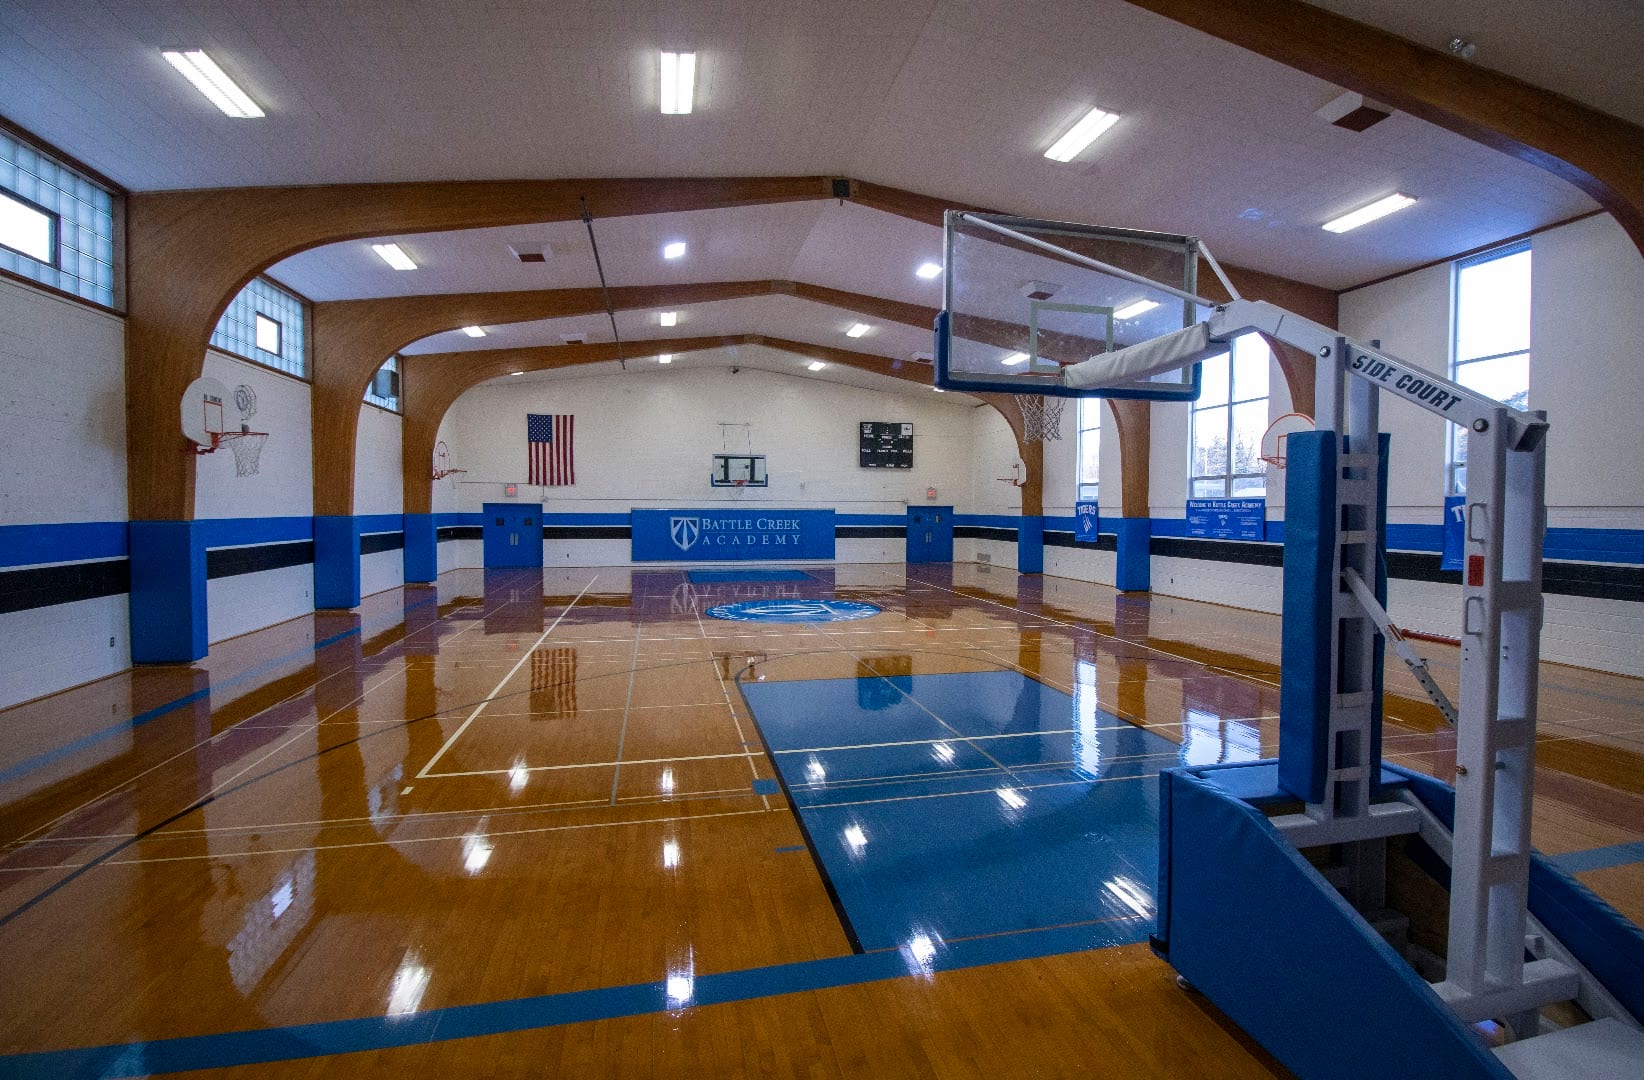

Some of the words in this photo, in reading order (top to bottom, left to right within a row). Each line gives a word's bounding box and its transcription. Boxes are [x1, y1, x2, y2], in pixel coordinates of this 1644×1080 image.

[1352, 355, 1397, 382] SIDE
[1395, 374, 1462, 411] COURT
[1077, 504, 1097, 516] TIGERS
[702, 518, 752, 530] BATTLE
[756, 518, 800, 530] CREEK
[702, 534, 801, 545] ACADEMY
